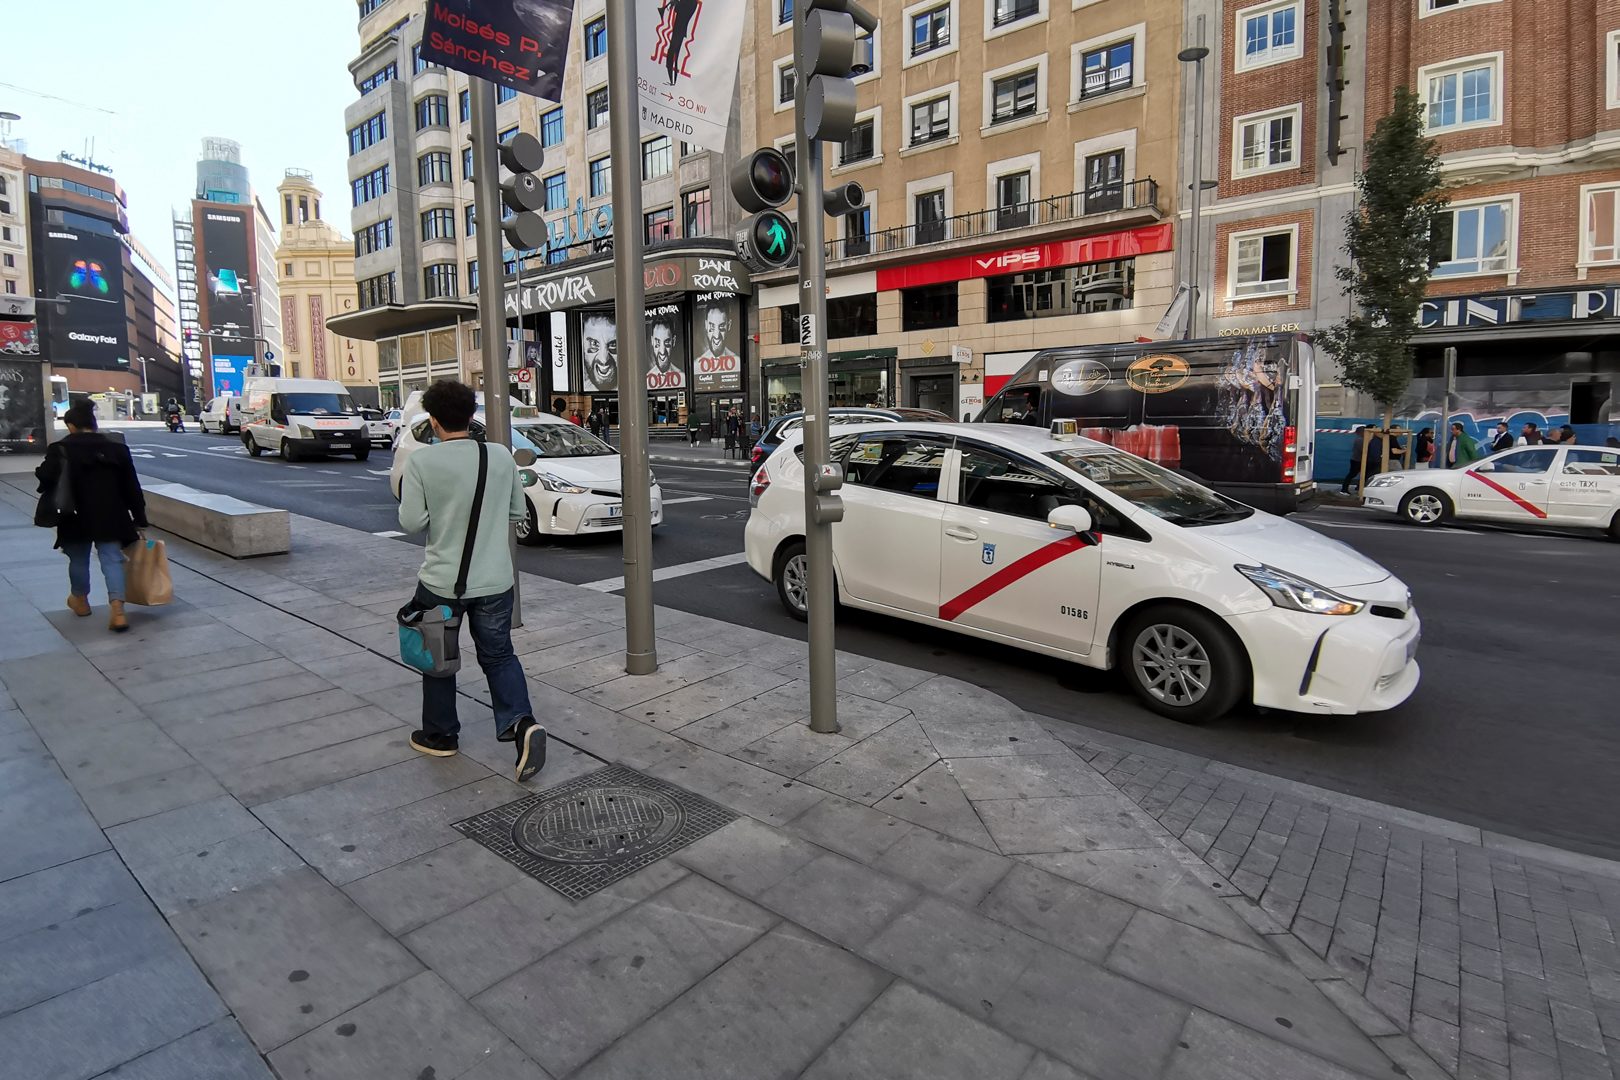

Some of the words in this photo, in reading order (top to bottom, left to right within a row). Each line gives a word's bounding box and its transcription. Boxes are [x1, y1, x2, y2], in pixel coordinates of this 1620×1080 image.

[433, 2, 511, 47] Moisés
[520, 35, 542, 58] P.
[430, 31, 530, 81] Sánchez
[677, 95, 694, 110] 30
[696, 103, 707, 115] NOV
[650, 112, 694, 136] MADRID
[207, 213, 241, 223] SAMSUNG
[975, 249, 1041, 269] VIPS
[644, 263, 682, 291] DIO
[698, 259, 732, 274] DANI
[692, 274, 739, 292] ROVIRA
[505, 288, 532, 316] ANI
[535, 275, 596, 311] ROVIRA
[696, 292, 713, 303] DANI
[657, 304, 680, 317] ROVIRA
[68, 331, 100, 345] Galaxy
[100, 336, 118, 345] Fold
[343, 299, 356, 377] CLAO
[1218, 327, 1250, 338] ROOM
[1251, 324, 1278, 335] MATE
[1280, 322, 1300, 332] REX
[698, 355, 736, 373] ODIO
[646, 371, 682, 389] ODIO
[1579, 480, 1599, 488] TAXI
[1060, 605, 1089, 620] 01586
